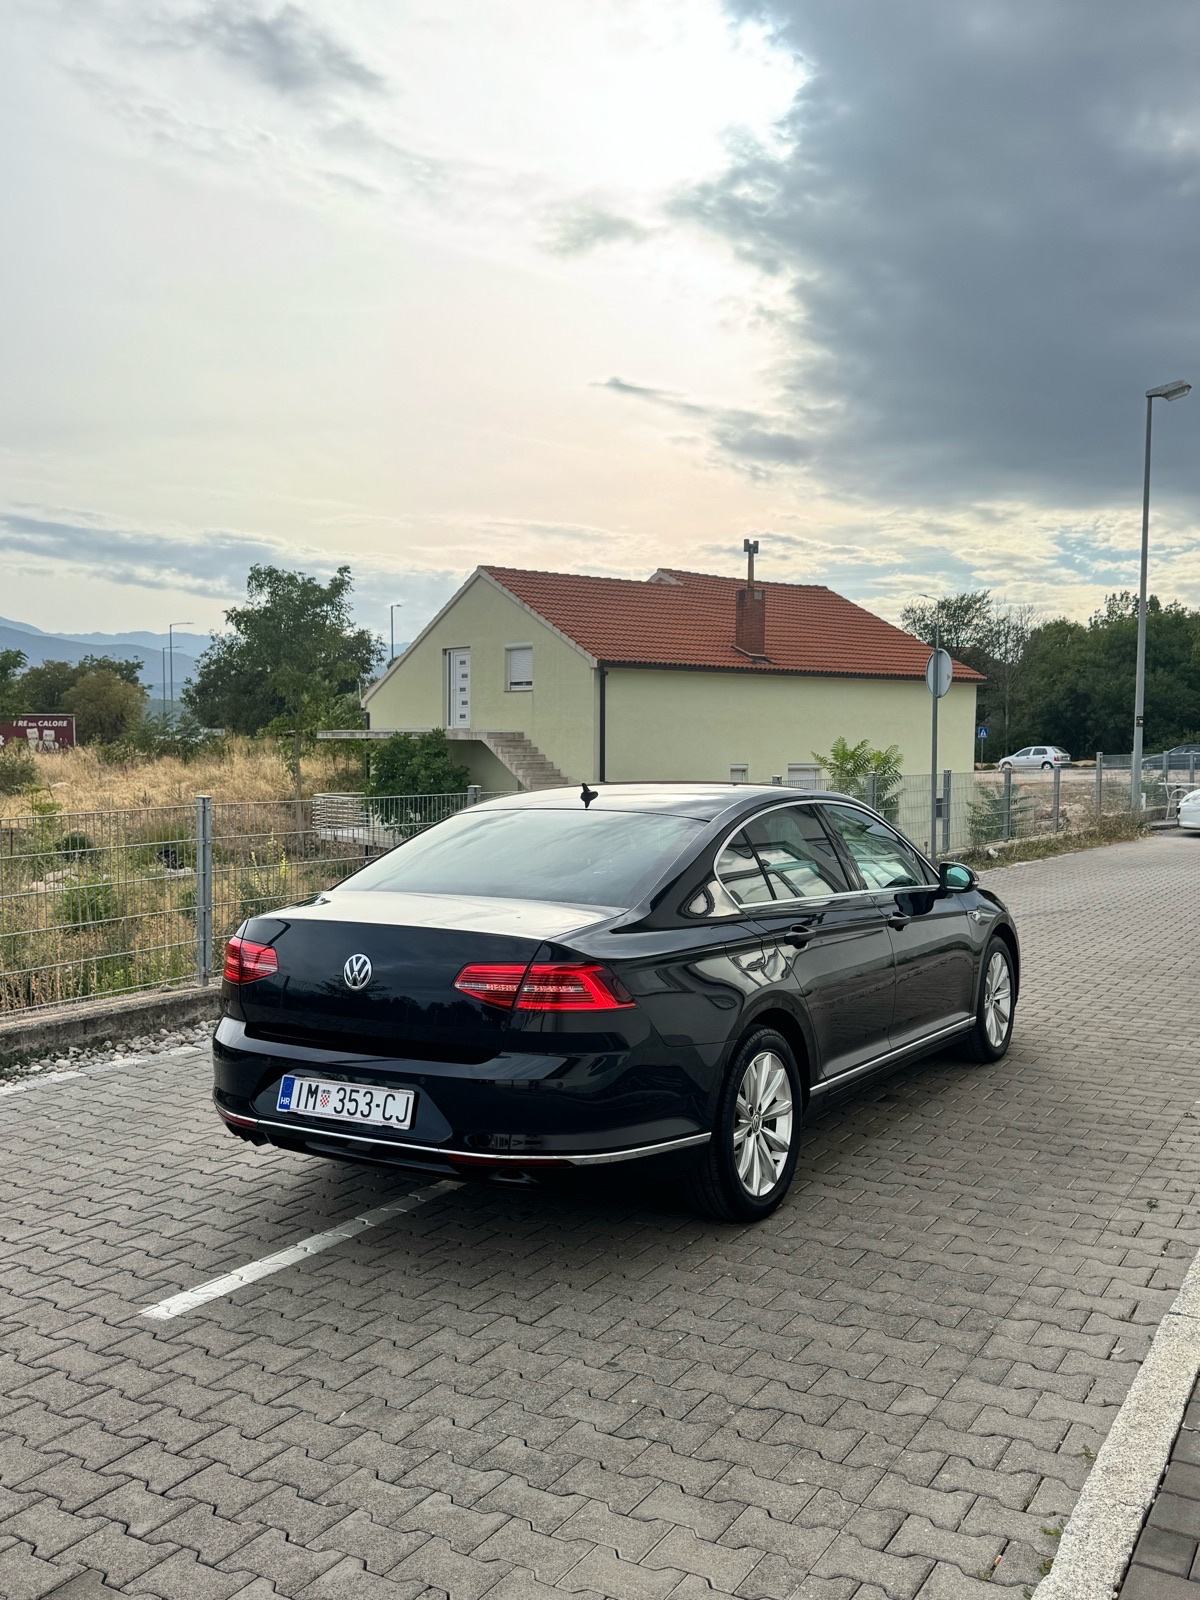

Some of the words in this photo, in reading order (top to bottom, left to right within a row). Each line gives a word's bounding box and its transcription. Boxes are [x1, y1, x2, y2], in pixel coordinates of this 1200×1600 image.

[343, 953, 372, 990] VW
[280, 1096, 291, 1106] HR
[296, 1082, 320, 1111] IM
[333, 1086, 410, 1123] 353-CJ
